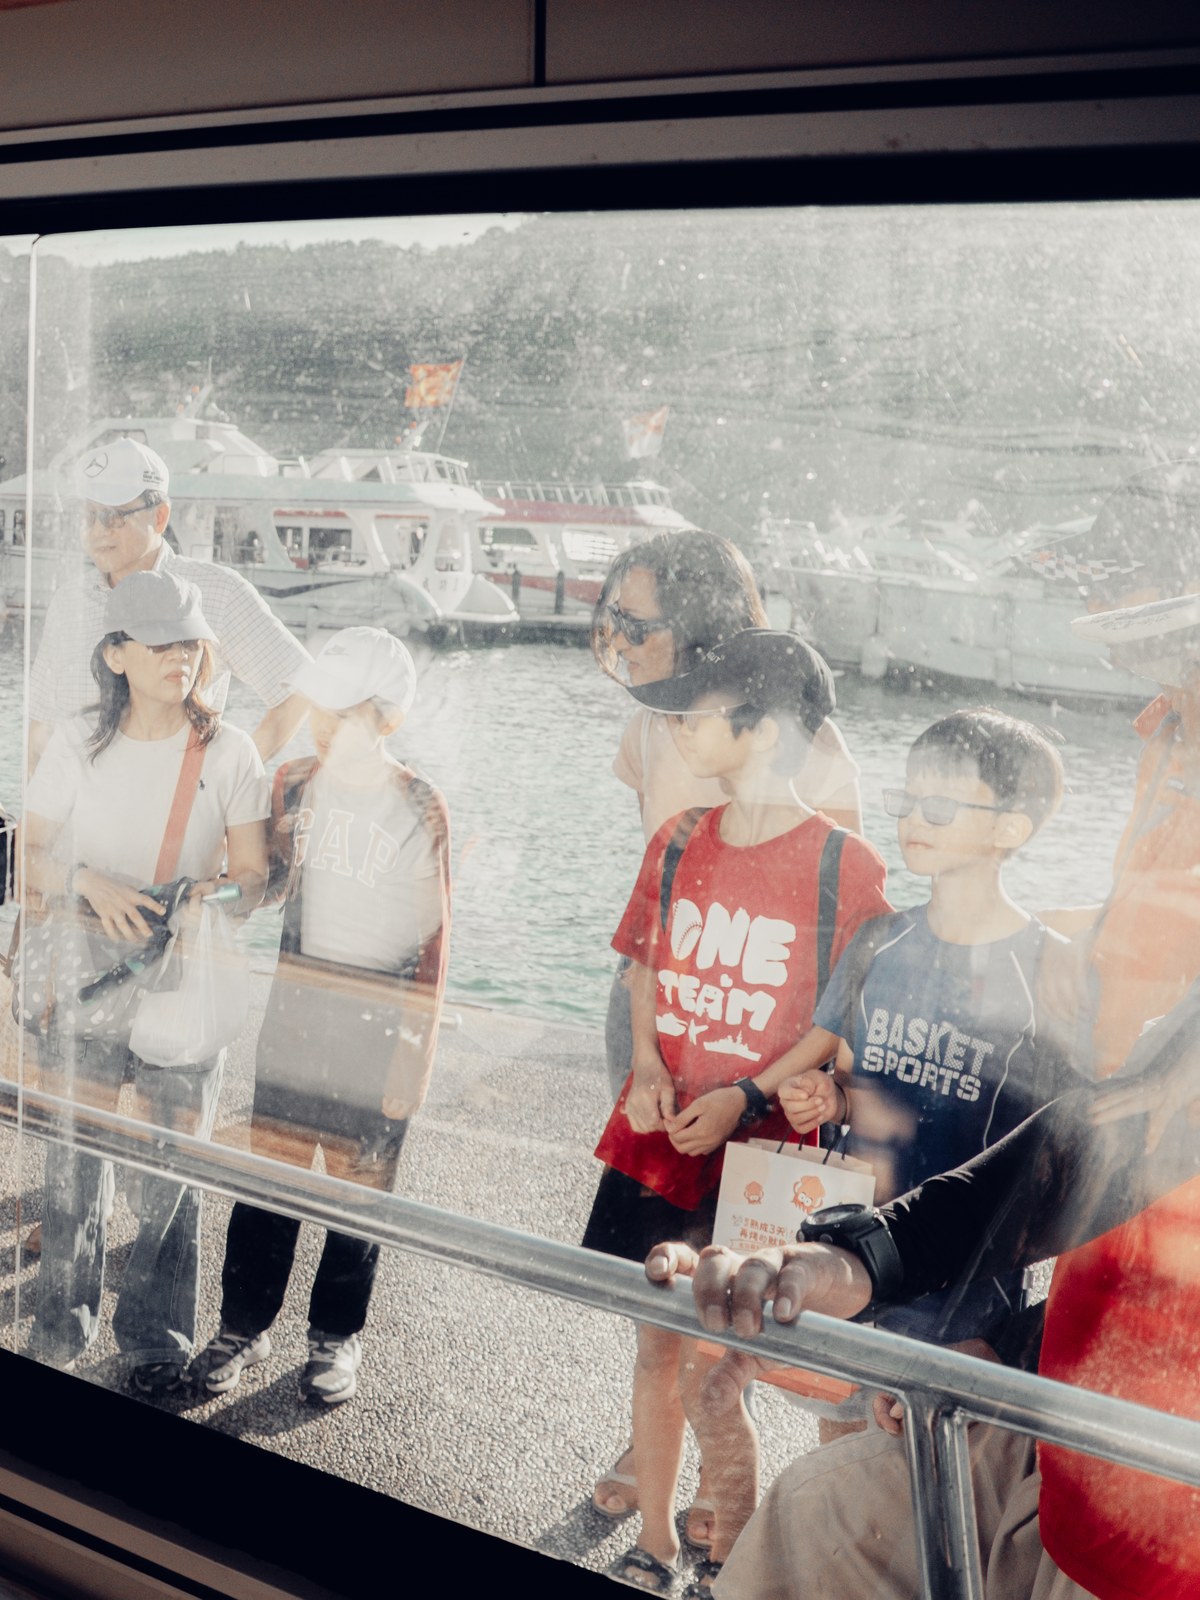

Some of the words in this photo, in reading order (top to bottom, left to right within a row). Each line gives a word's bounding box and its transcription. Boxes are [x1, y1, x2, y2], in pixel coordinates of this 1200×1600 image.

[293, 807, 399, 888] GAP
[670, 898, 797, 987] ONE
[658, 969, 777, 1032] TEAM
[862, 1045, 982, 1102] SPORTS
[866, 1008, 995, 1077] BASKET
